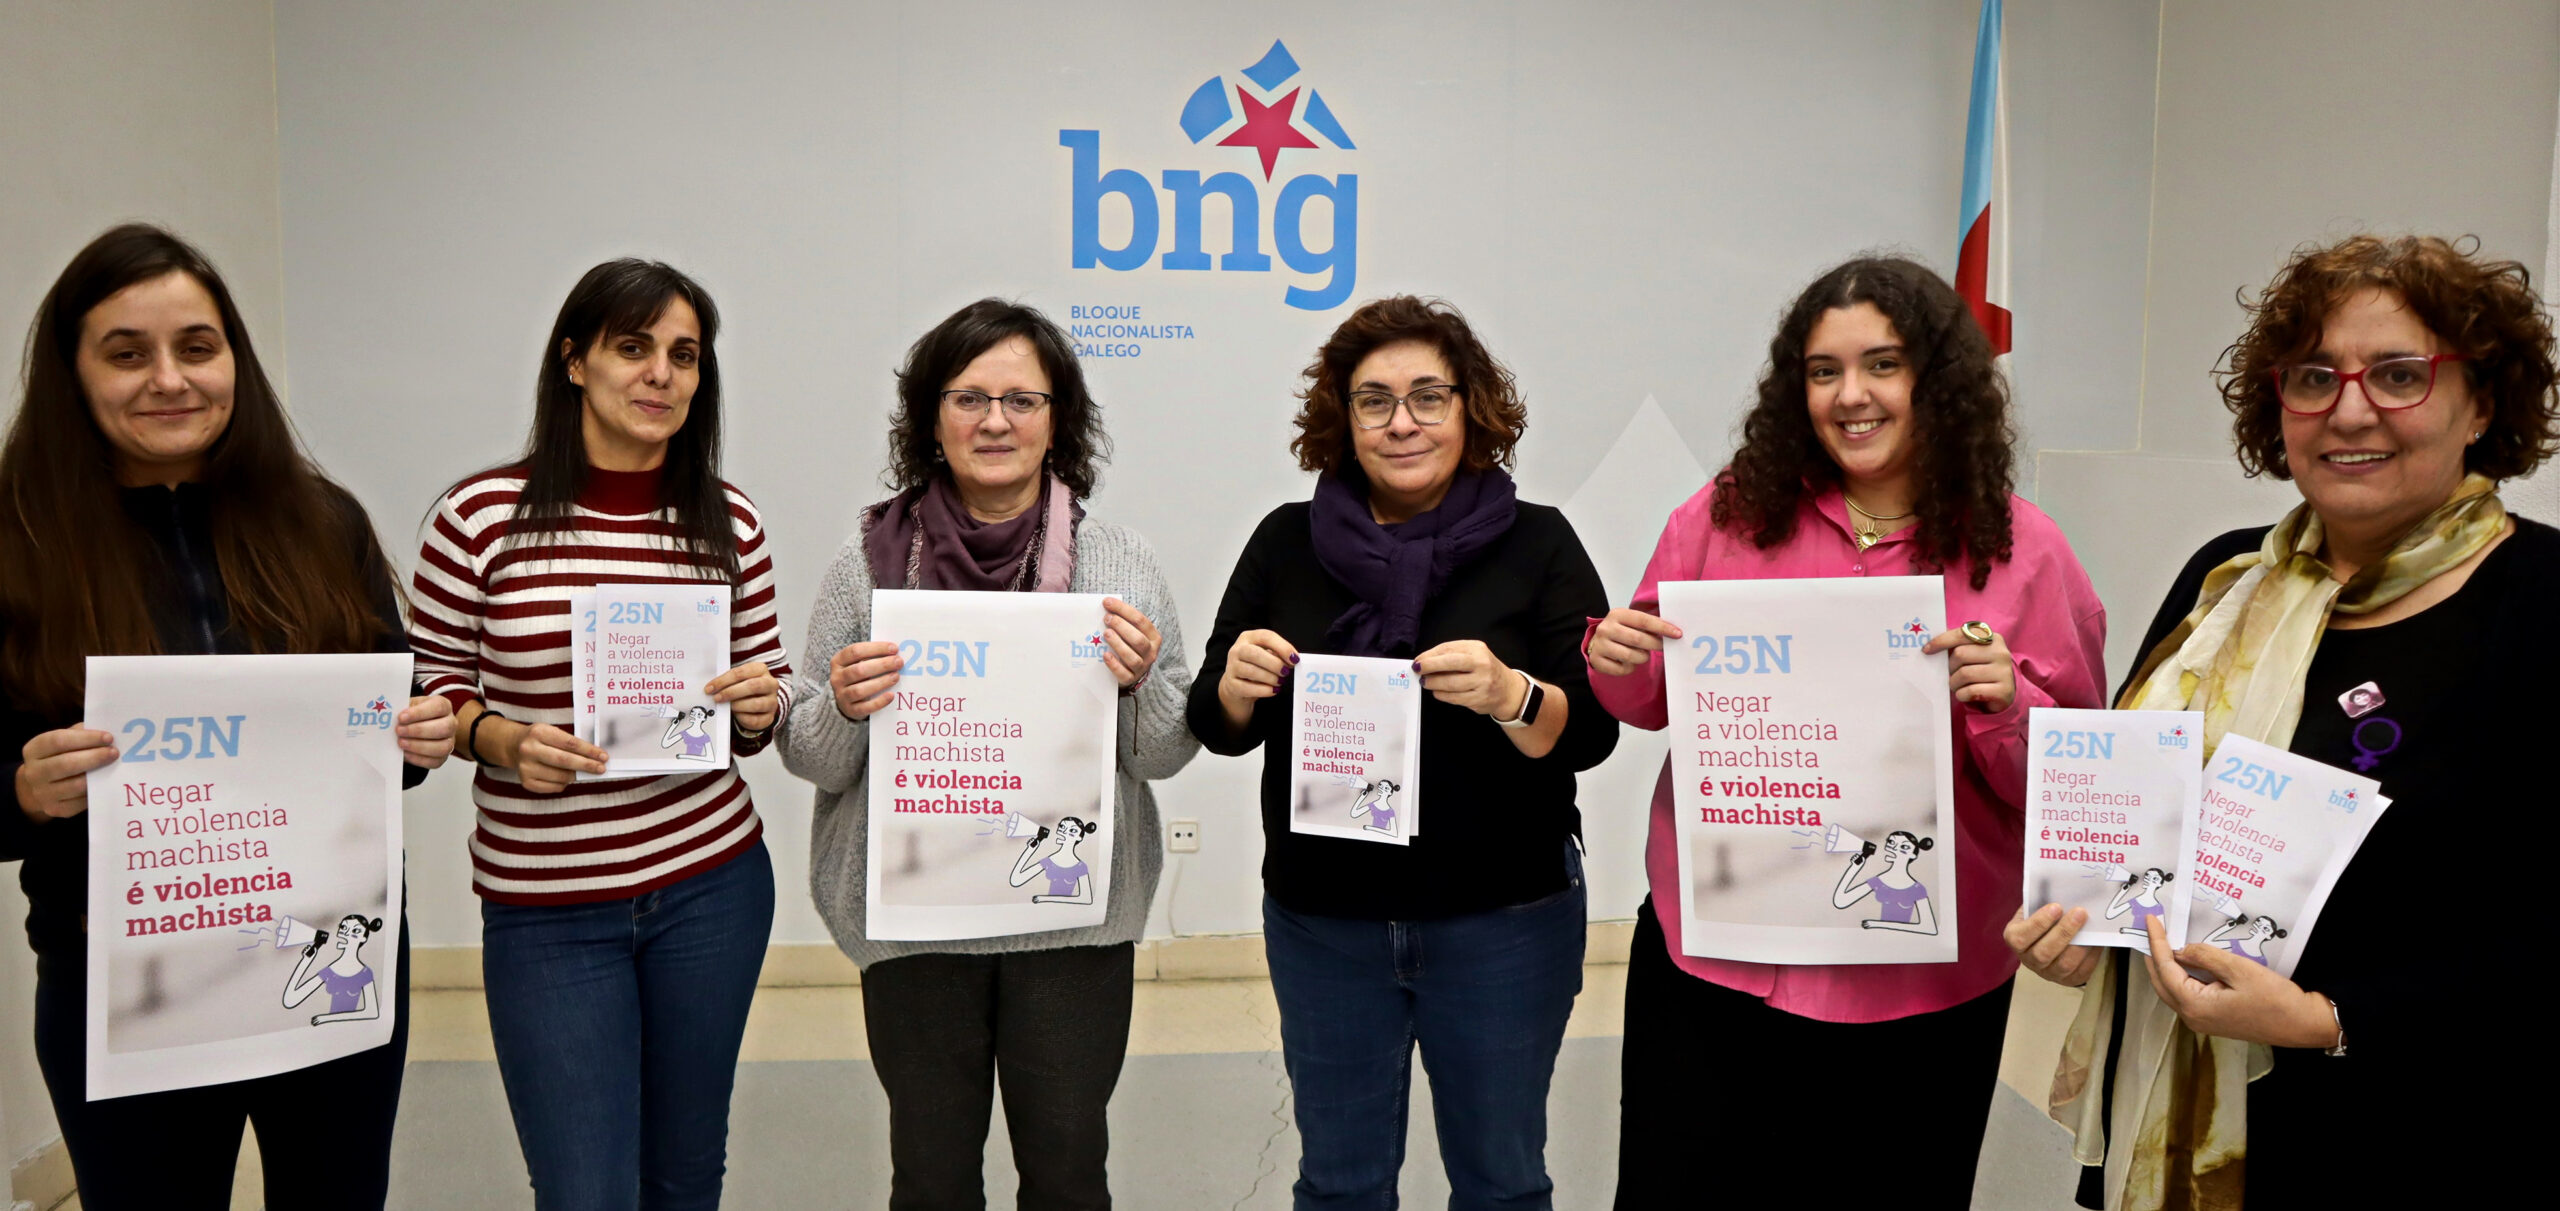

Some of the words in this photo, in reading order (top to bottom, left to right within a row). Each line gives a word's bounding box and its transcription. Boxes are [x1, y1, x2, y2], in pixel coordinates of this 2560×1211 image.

[1059, 129, 1358, 311] bng
[1071, 306, 1141, 319] BLOQUE
[1071, 325, 1194, 338] NACIONALISTA
[1072, 344, 1141, 357] GALEGO
[608, 602, 664, 624] 25N
[697, 602, 720, 615] bng
[608, 633, 650, 647] Negar
[608, 650, 615, 659] a
[621, 648, 685, 659] violencia
[898, 640, 990, 677] 25N
[1692, 634, 1792, 674] 25N
[608, 663, 674, 674] machista
[607, 679, 615, 690] é
[619, 678, 684, 690] violencia
[1305, 672, 1357, 695] 25N
[1388, 675, 1409, 689] bng
[607, 693, 674, 704] machista
[896, 692, 966, 716] Negar
[1696, 692, 1771, 718] Negar
[347, 708, 393, 729] bng
[1304, 702, 1344, 717] Negar
[896, 721, 909, 736] a
[916, 718, 1023, 738] violencia
[1304, 718, 1312, 727] a
[1315, 716, 1376, 731] violencia
[1697, 722, 1711, 741] a
[1719, 718, 1838, 741] violencia
[121, 714, 246, 763] 25N
[1304, 731, 1365, 745] machista
[2044, 730, 2115, 760] 25N
[2158, 731, 2188, 749] bng
[896, 742, 1005, 762] machista
[1303, 746, 1310, 756] é
[1314, 748, 1374, 761] violencia
[1698, 746, 1819, 768] machista
[1303, 761, 1364, 775] machista
[895, 770, 908, 789] é
[914, 770, 1022, 790] violencia
[1699, 777, 1713, 796] é
[1720, 776, 1841, 799] violencia
[2042, 769, 2096, 788] Negar
[2217, 756, 2293, 801] 25N
[123, 782, 214, 810] Negar
[894, 795, 1004, 814] machista
[2042, 791, 2052, 802] a
[2058, 787, 2141, 806] violencia
[2203, 789, 2256, 819] Negar
[2328, 789, 2359, 814] bng
[126, 820, 144, 838] a
[153, 804, 288, 833] violencia
[1700, 803, 1822, 826] machista
[2041, 807, 2127, 825] machista
[2041, 828, 2050, 841] é
[2056, 828, 2139, 846] violencia
[2210, 812, 2286, 853] violencia
[126, 837, 269, 870] machista
[2040, 847, 2125, 864] machista
[2199, 828, 2264, 864] achista
[126, 883, 145, 905] é
[153, 867, 292, 902] violencia
[125, 902, 272, 936] machista
